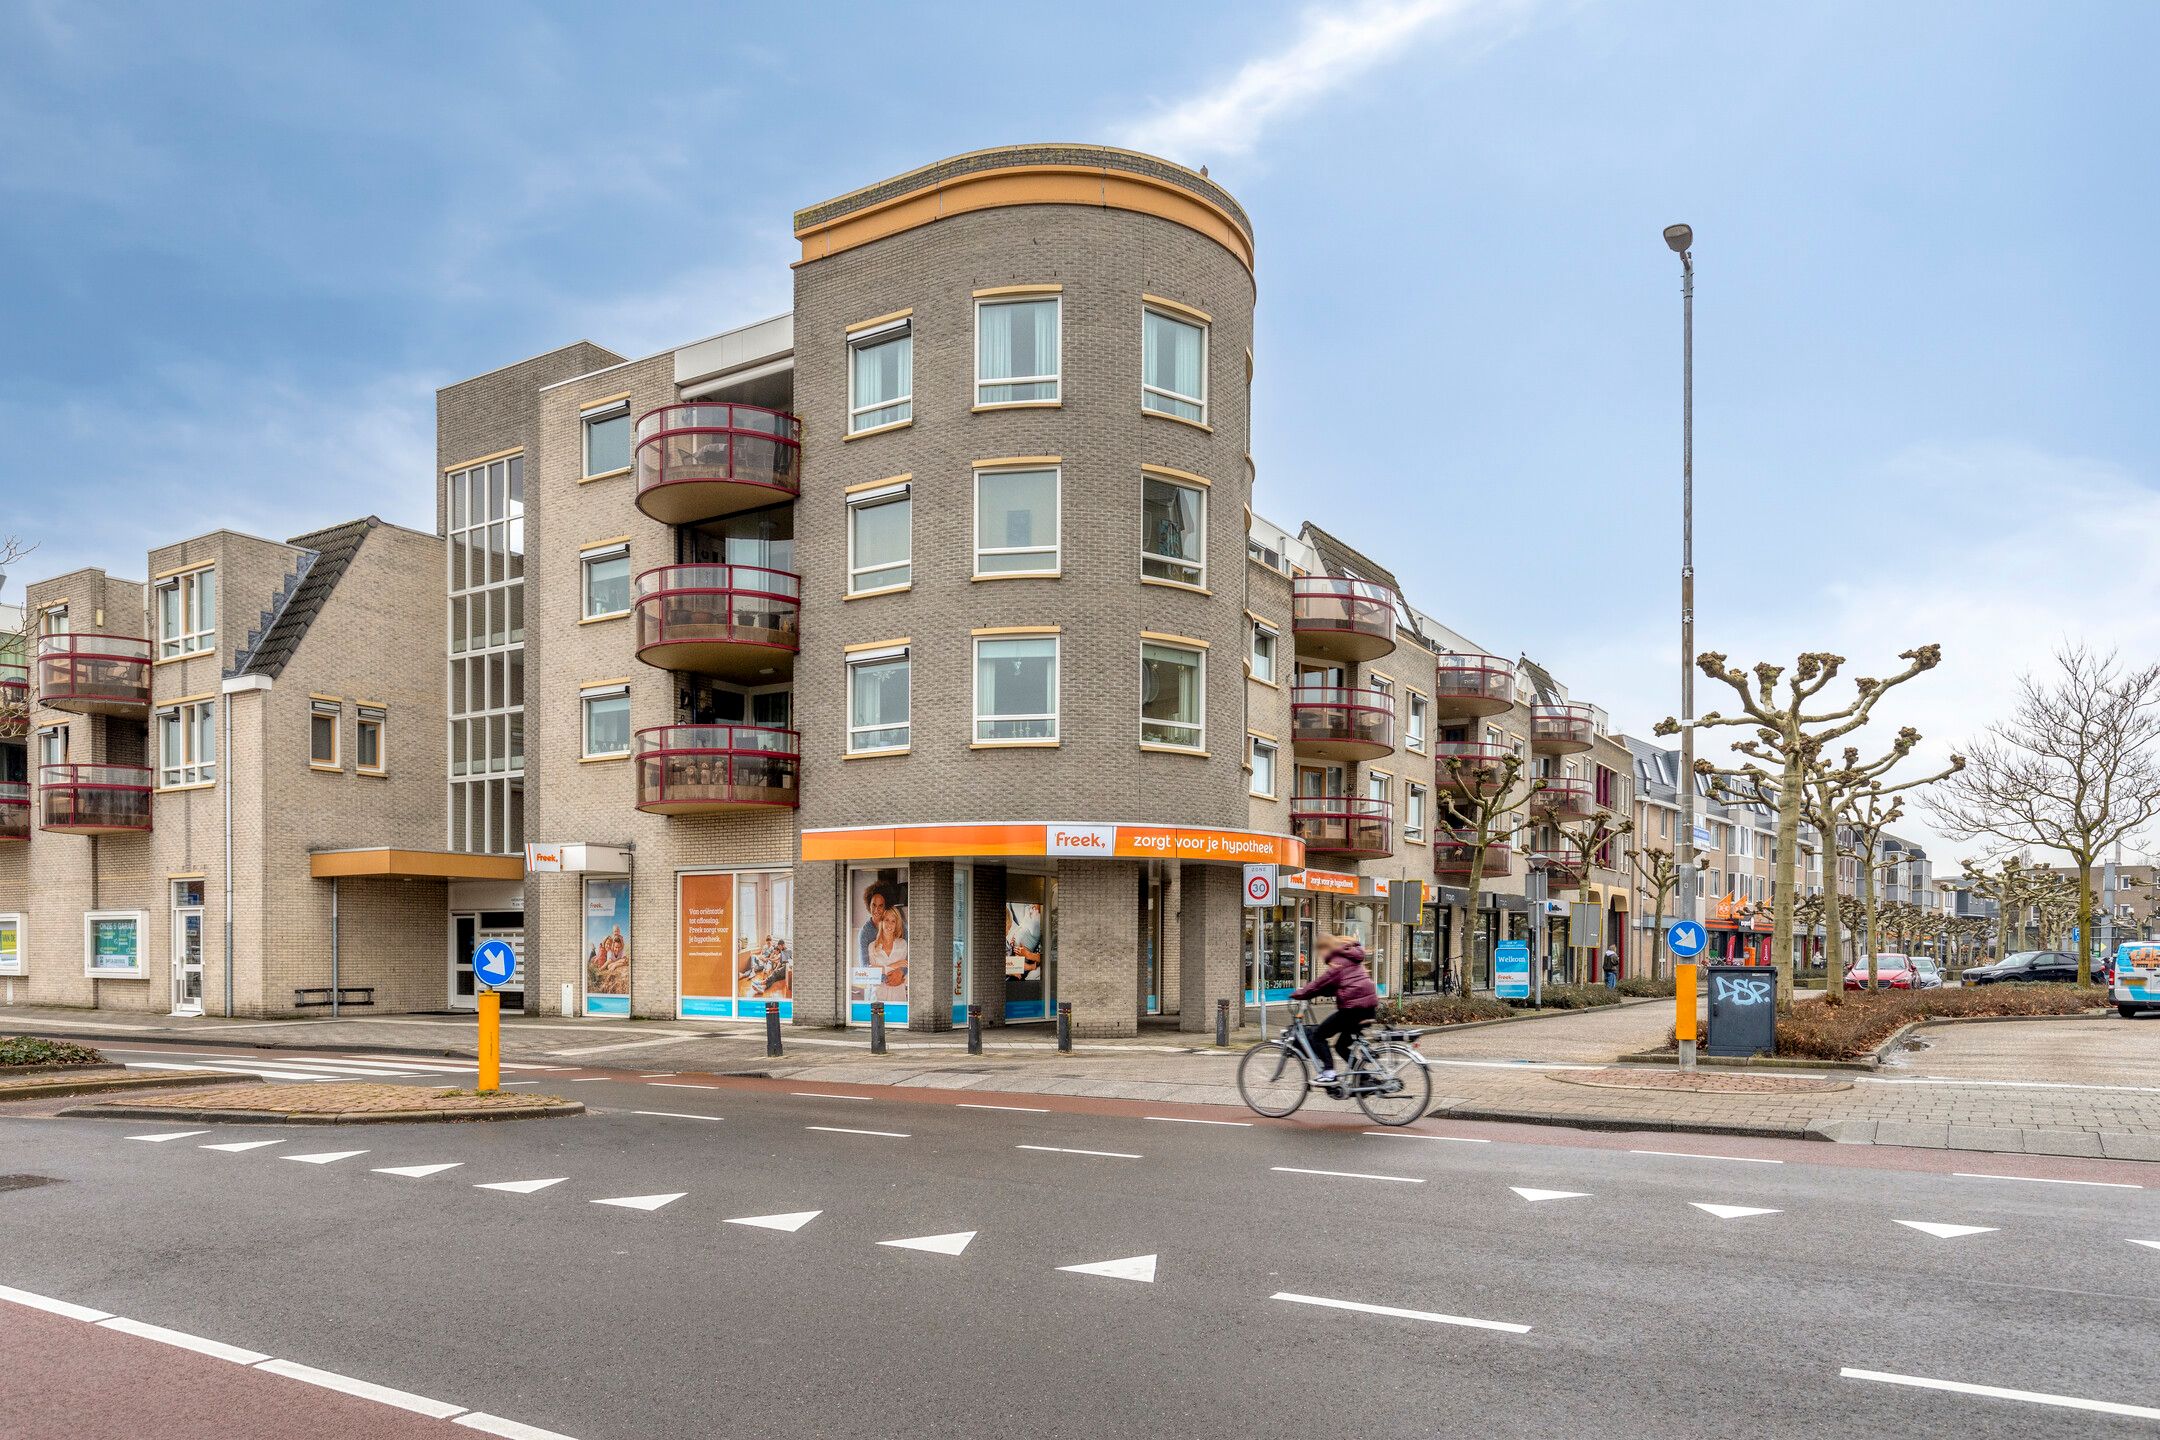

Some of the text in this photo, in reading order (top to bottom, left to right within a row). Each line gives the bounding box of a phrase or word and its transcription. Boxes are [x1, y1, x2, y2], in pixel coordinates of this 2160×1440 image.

[1133, 834, 1274, 854] zorgt voor je hypotheek
[1252, 884, 1266, 892] 30
[1498, 955, 1526, 963] Welkom
